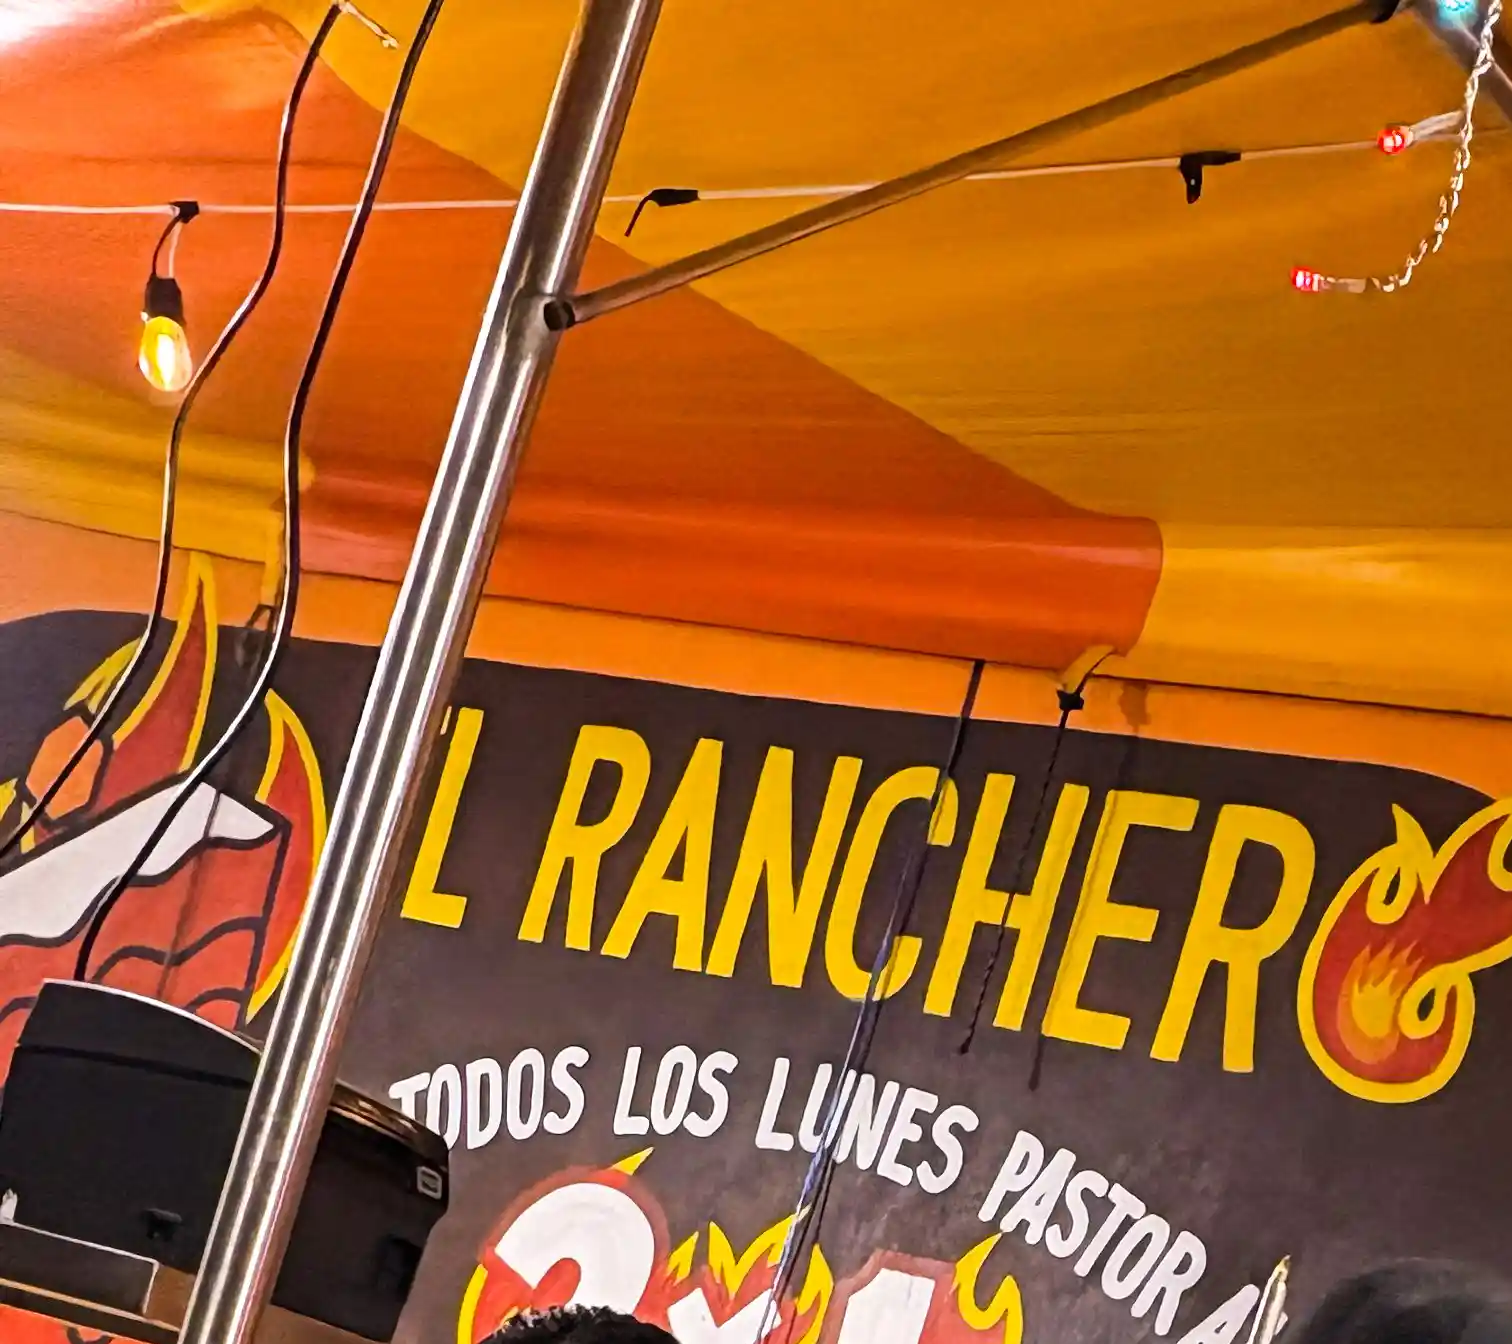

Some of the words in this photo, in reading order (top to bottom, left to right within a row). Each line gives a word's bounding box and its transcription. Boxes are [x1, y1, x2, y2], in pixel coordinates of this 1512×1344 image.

[401, 706, 484, 929] L
[388, 1045, 590, 1152] TODOS
[613, 1044, 740, 1138] LOS
[754, 1056, 980, 1195] LUNES
[978, 1130, 1207, 1336] PASTOR
